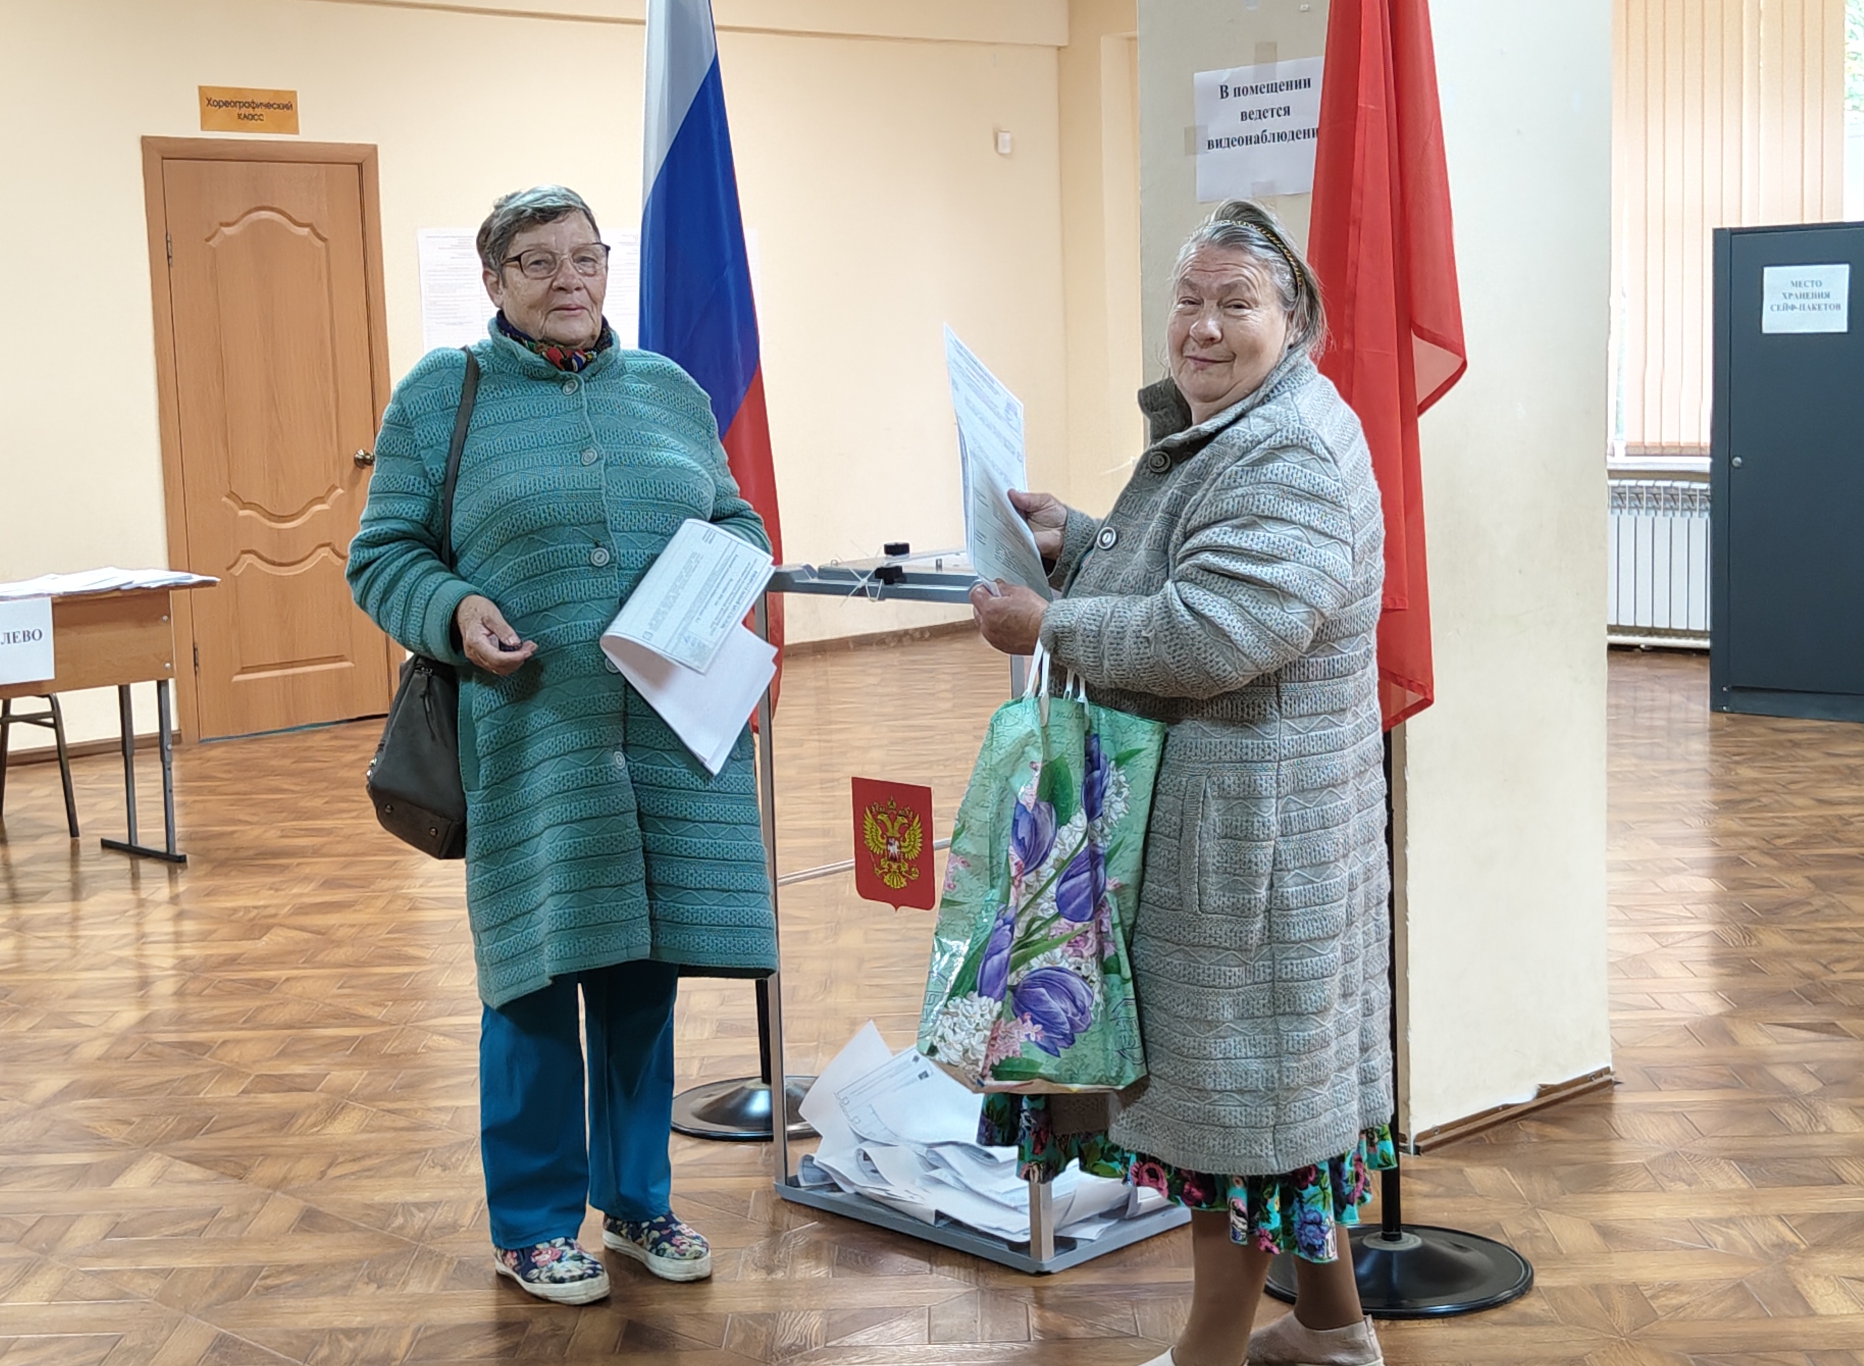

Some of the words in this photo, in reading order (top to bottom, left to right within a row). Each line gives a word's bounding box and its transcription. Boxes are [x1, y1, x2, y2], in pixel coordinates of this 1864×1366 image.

[1219, 84, 1230, 100] В
[1233, 78, 1311, 97] помещении
[206, 97, 293, 111] Хореографический
[237, 112, 265, 122] класс
[1240, 105, 1291, 121] ведется
[1790, 280, 1822, 288] МЕСТО
[1781, 291, 1831, 301] ХРАНЕНИЯ
[1769, 302, 1842, 313] СЕЙФ-ПАКЕТОВ
[0, 629, 42, 645] ЛЕВО
